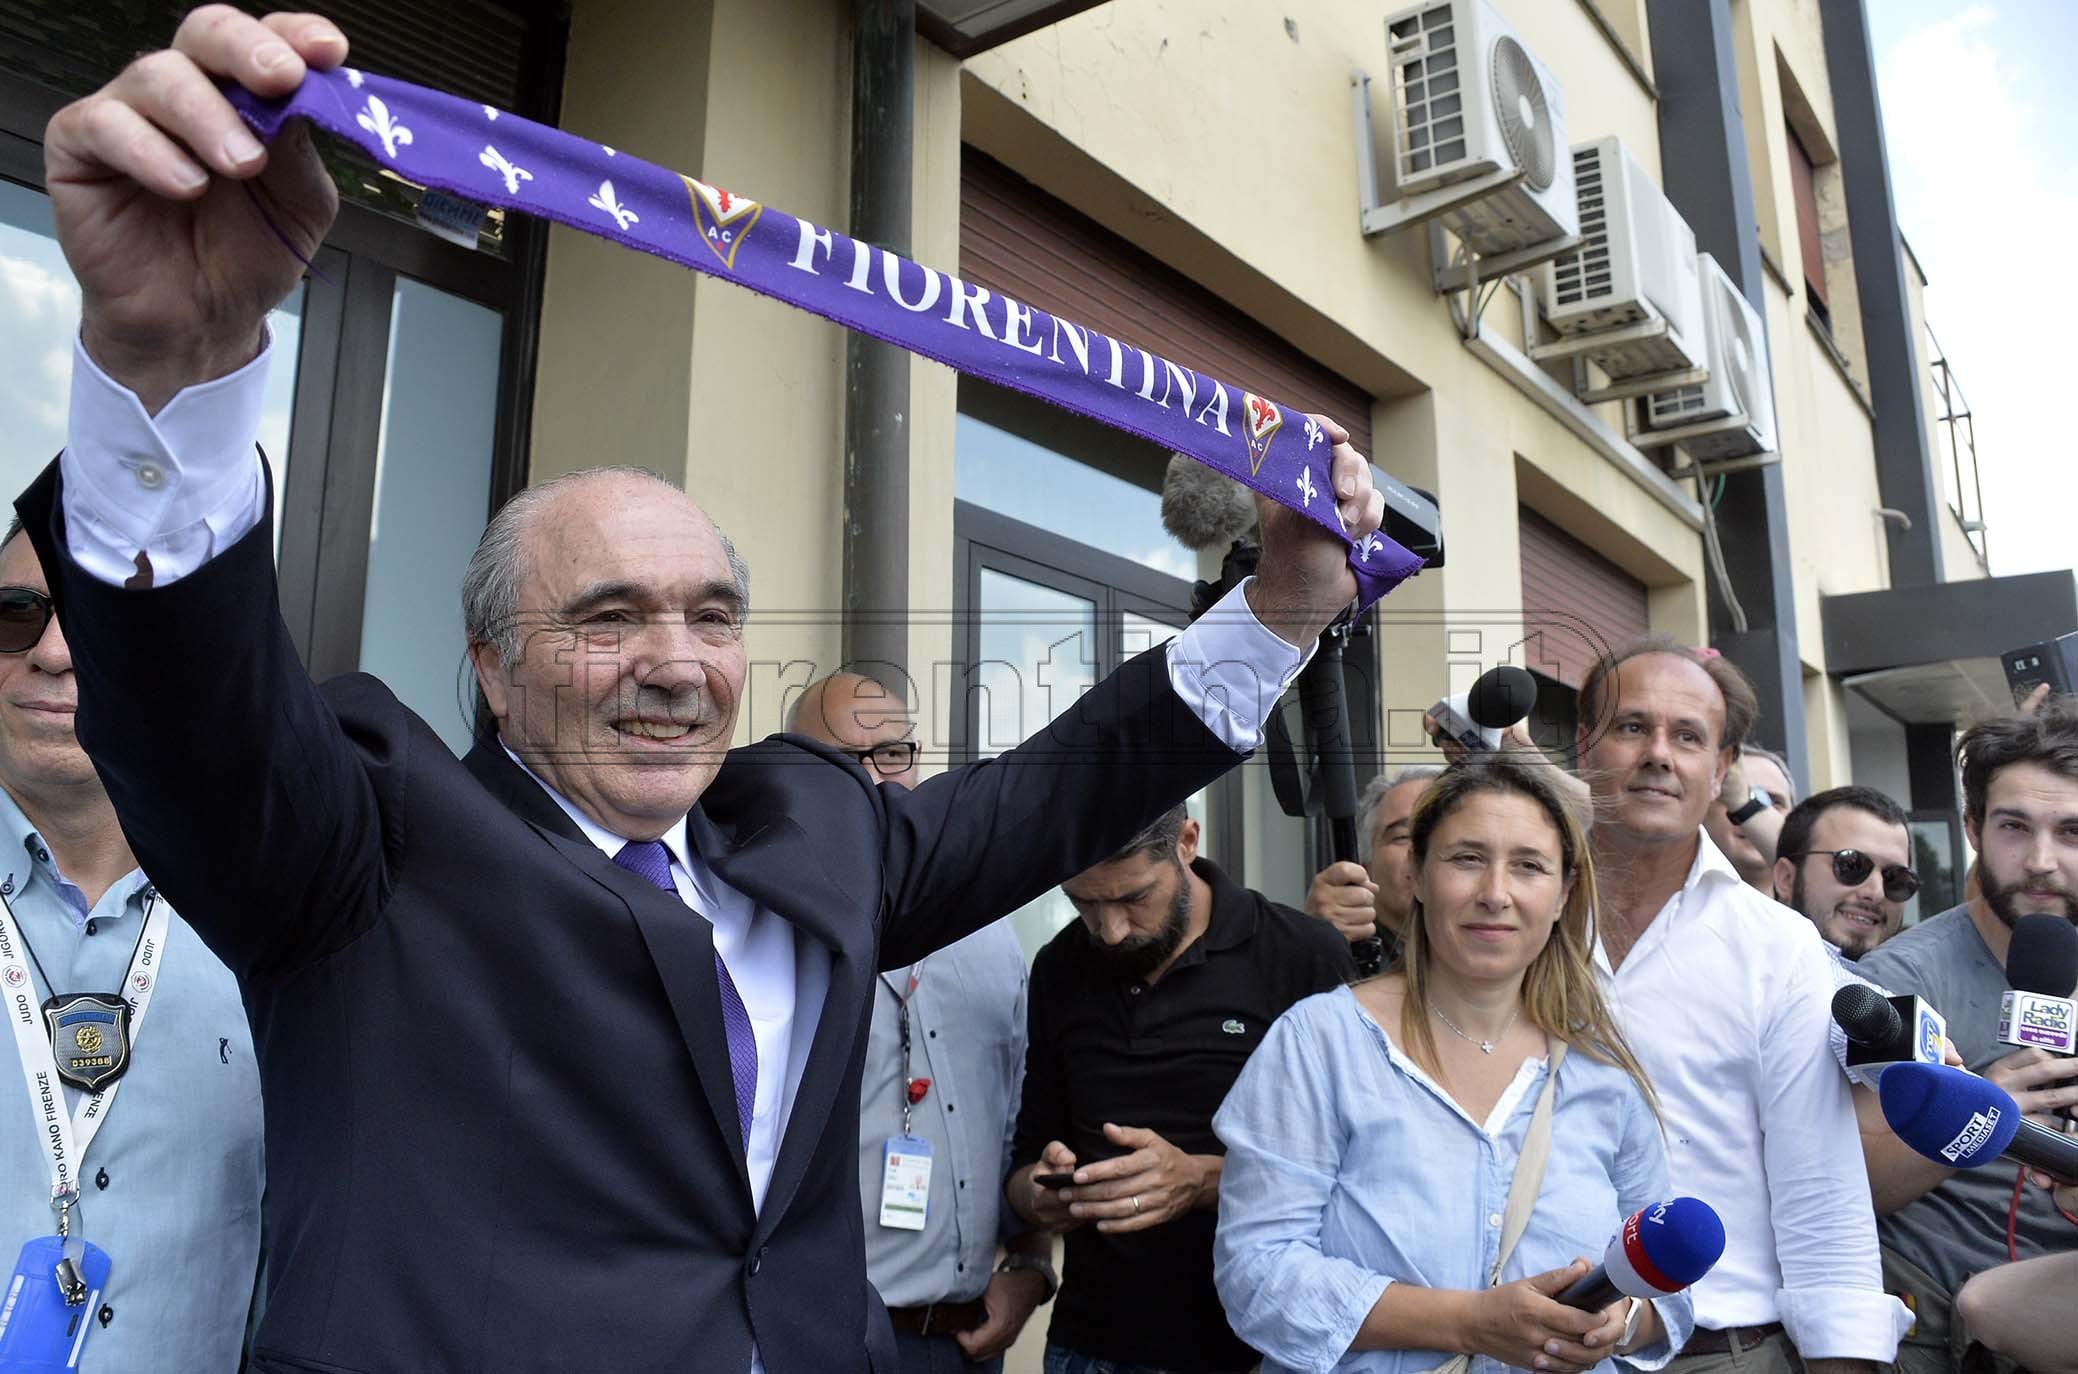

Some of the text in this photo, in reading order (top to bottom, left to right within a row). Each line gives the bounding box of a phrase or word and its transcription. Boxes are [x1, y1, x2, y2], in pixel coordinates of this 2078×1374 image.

[787, 217, 1233, 437] FIORENTINA
[141, 938, 155, 966] JUDO
[16, 994, 33, 1025] JUDO
[2023, 1011, 2067, 1030] Radio
[2030, 1001, 2070, 1020] Lady
[36, 1071, 58, 1122] FIRENZE
[48, 1124, 65, 1161] KANO
[1946, 1116, 1982, 1157] SPORT
[1966, 1111, 1998, 1154] MEDIASET
